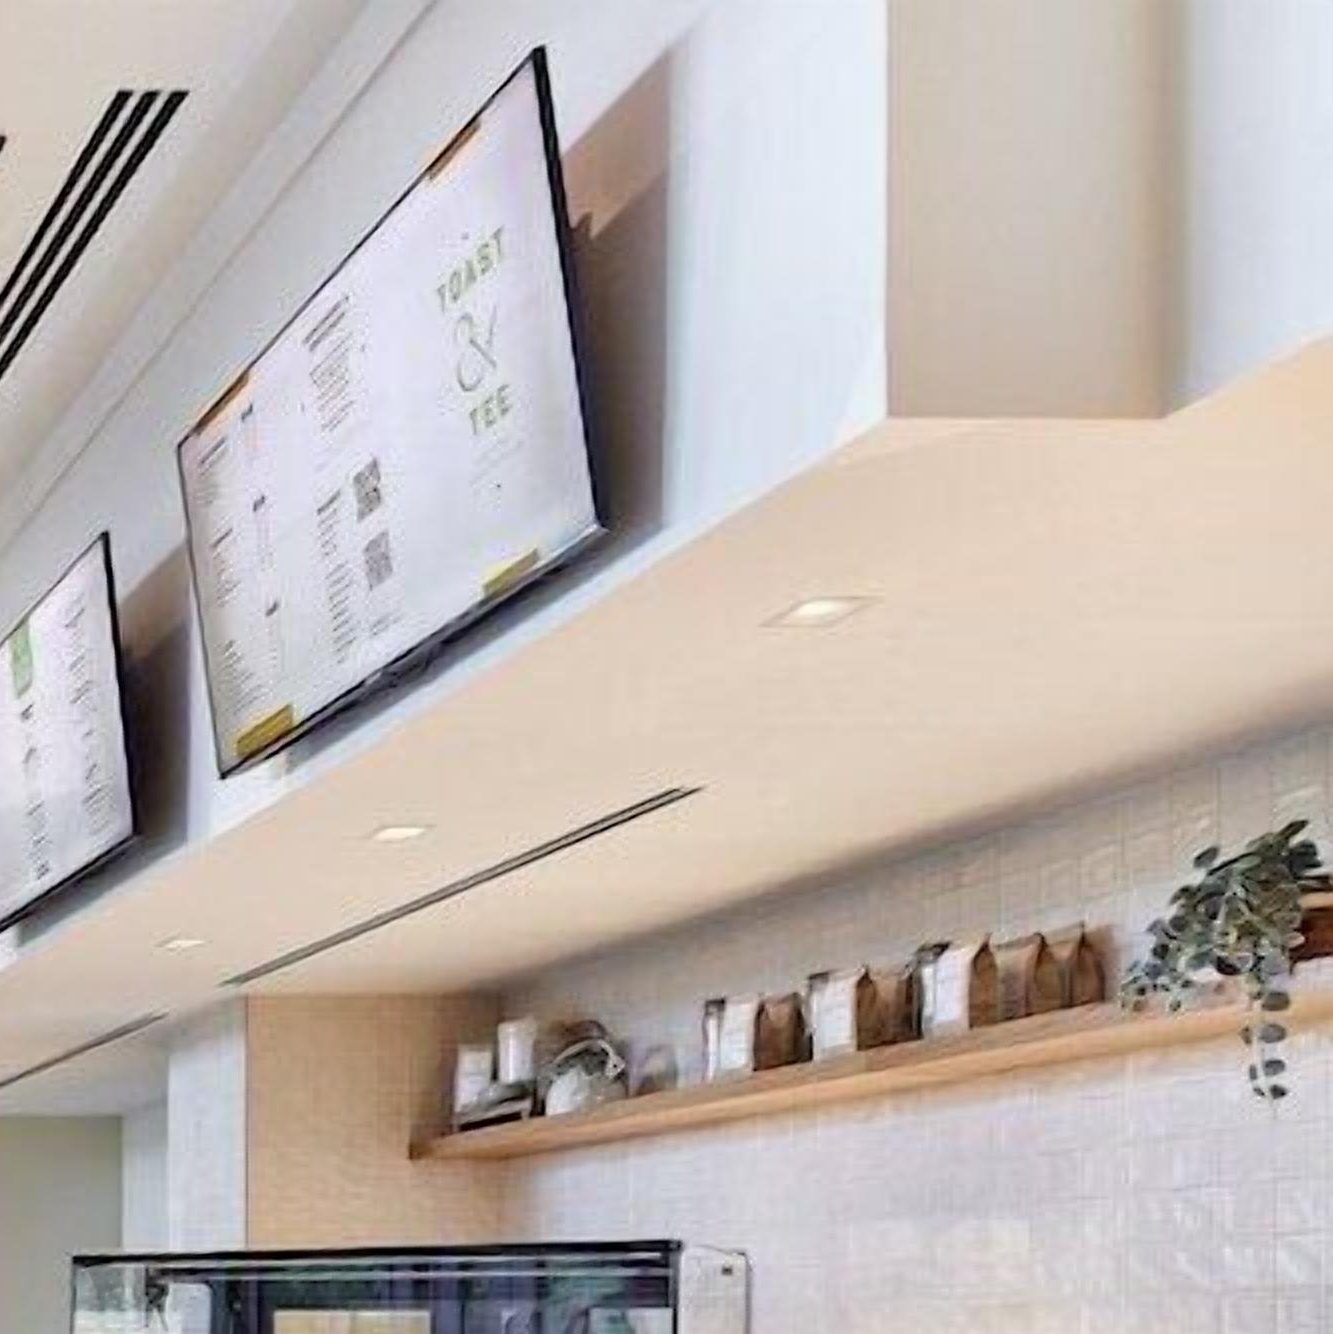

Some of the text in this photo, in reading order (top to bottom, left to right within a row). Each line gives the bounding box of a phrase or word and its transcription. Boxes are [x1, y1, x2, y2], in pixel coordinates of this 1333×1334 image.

[436, 224, 504, 312] TOAST
[454, 303, 498, 392] &
[469, 384, 512, 435] TEE
